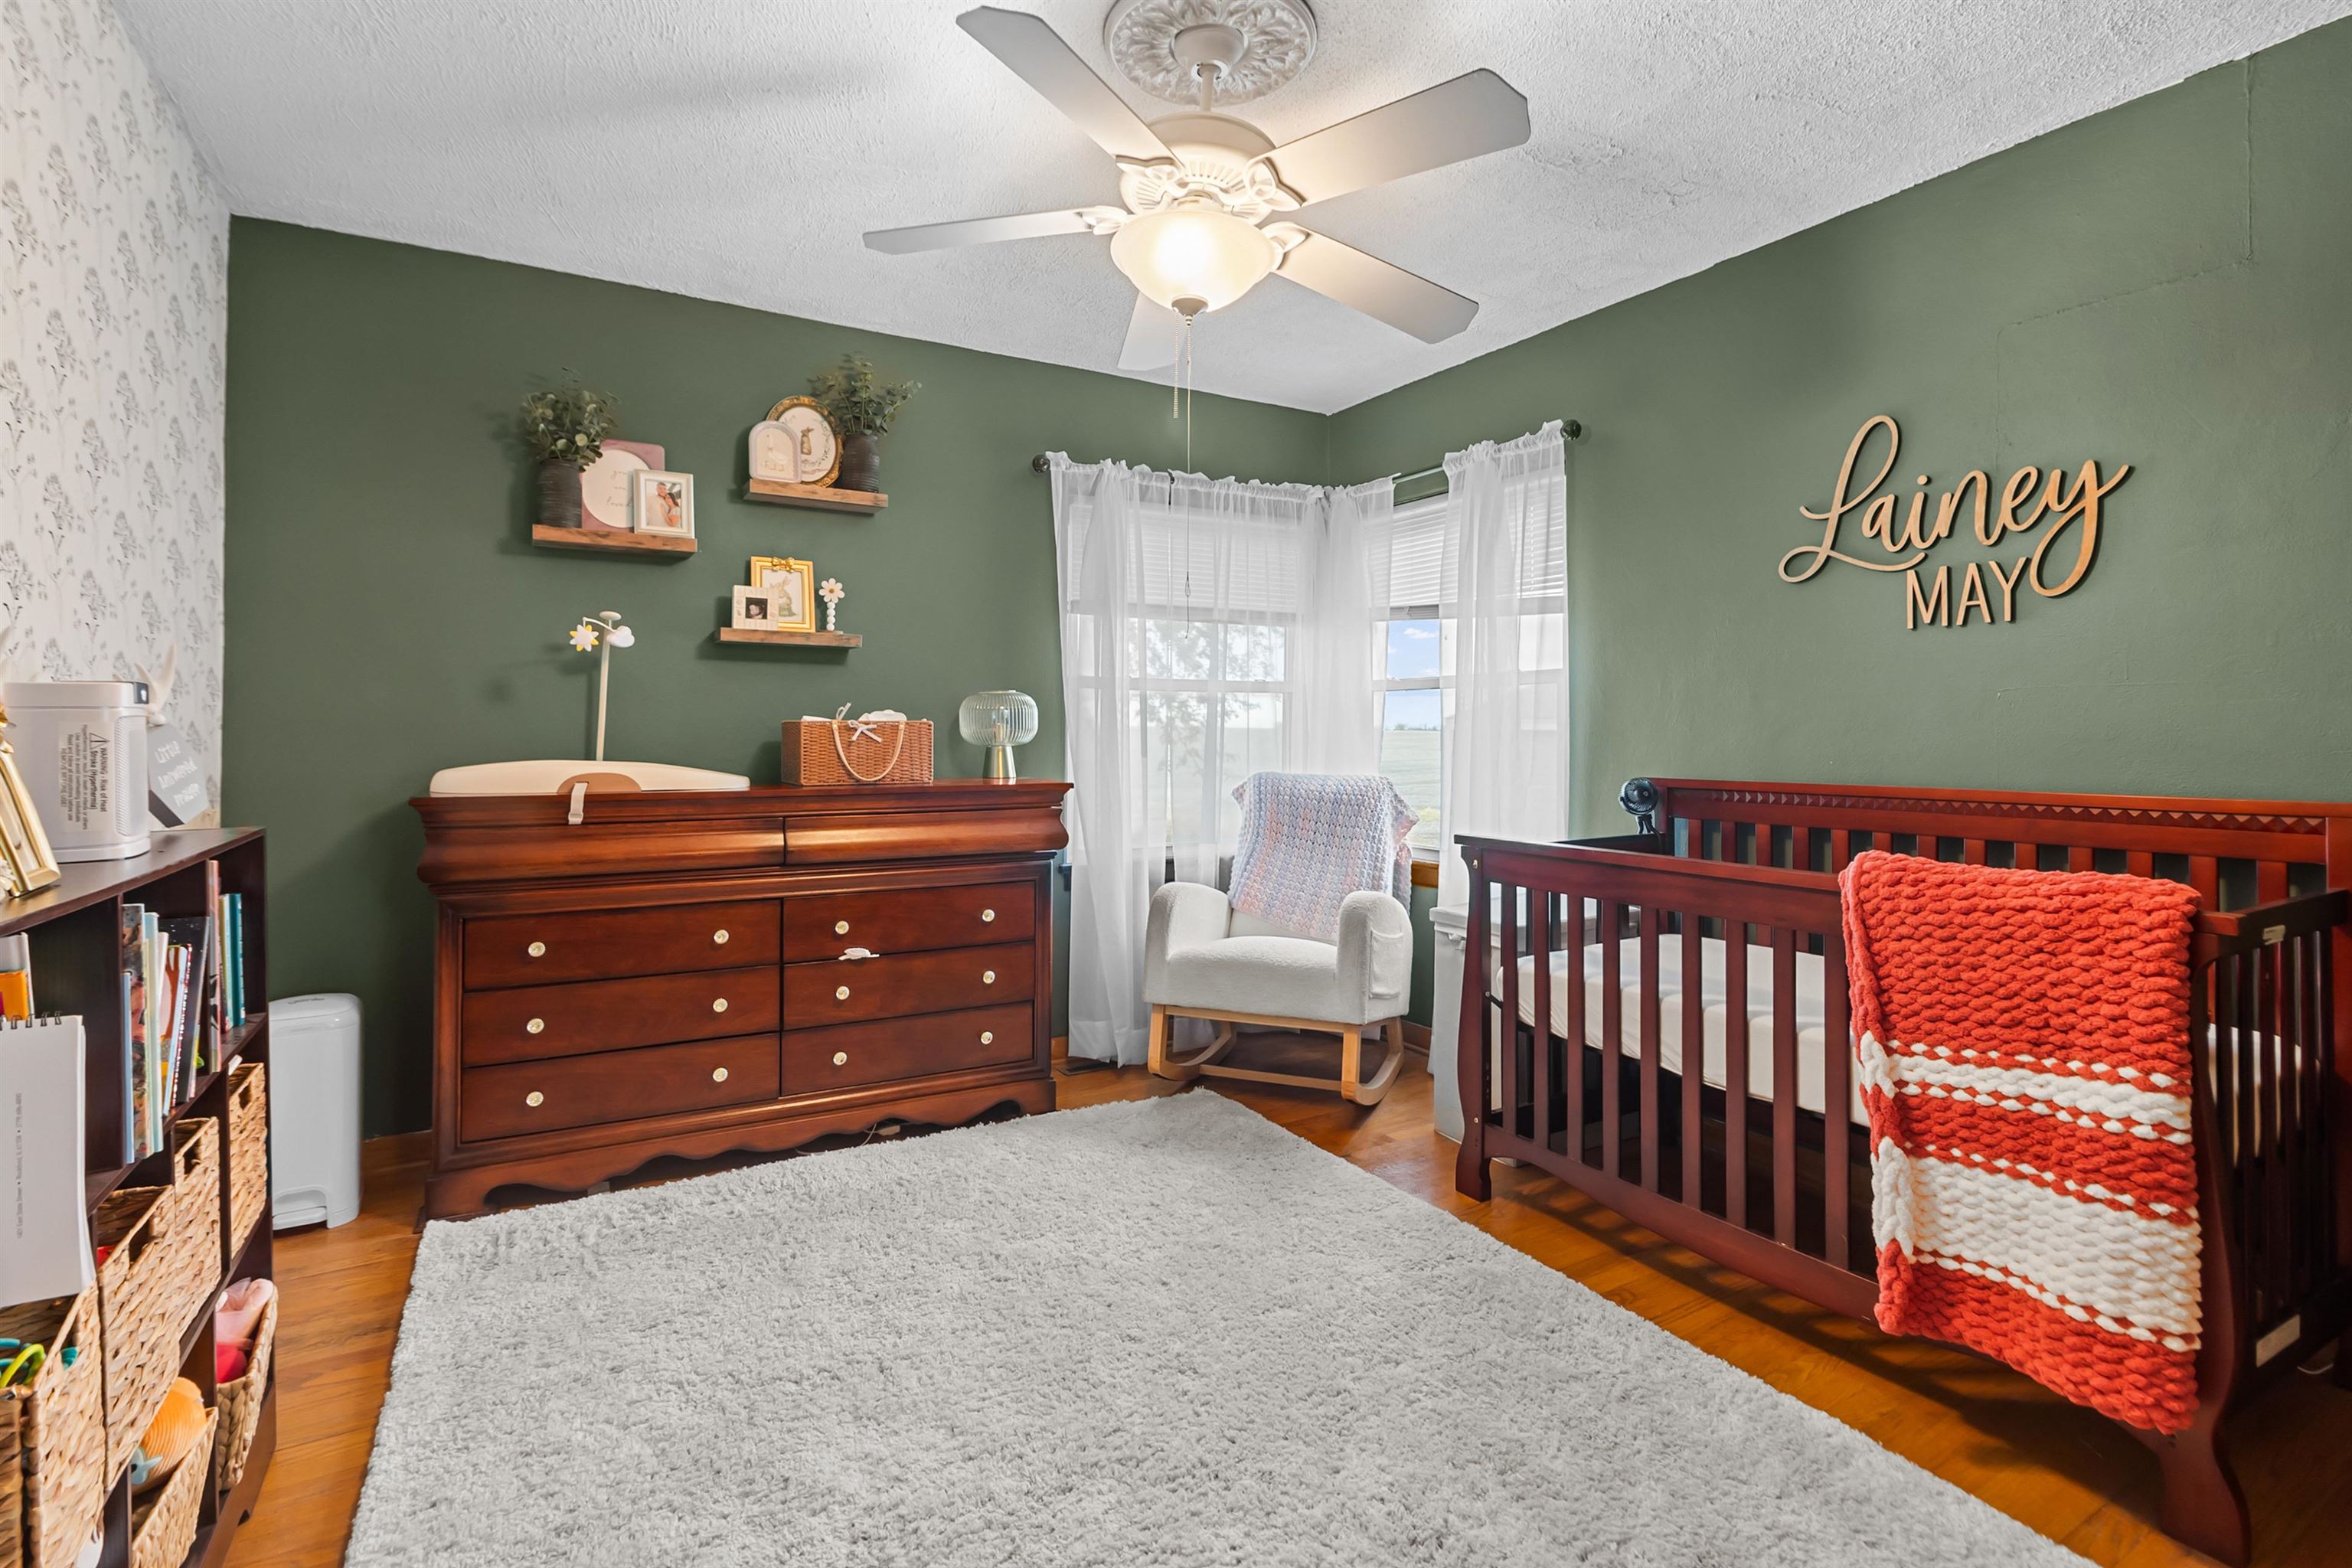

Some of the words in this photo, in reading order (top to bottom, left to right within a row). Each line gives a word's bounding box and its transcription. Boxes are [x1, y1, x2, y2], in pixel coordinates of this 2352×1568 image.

[1778, 414, 2129, 597] Lainey
[1906, 557, 2029, 630] MAY
[90, 750, 98, 768] Stroke
[100, 747, 108, 775] WARNING
[100, 779, 108, 791] Risk
[100, 799, 108, 812] Heat
